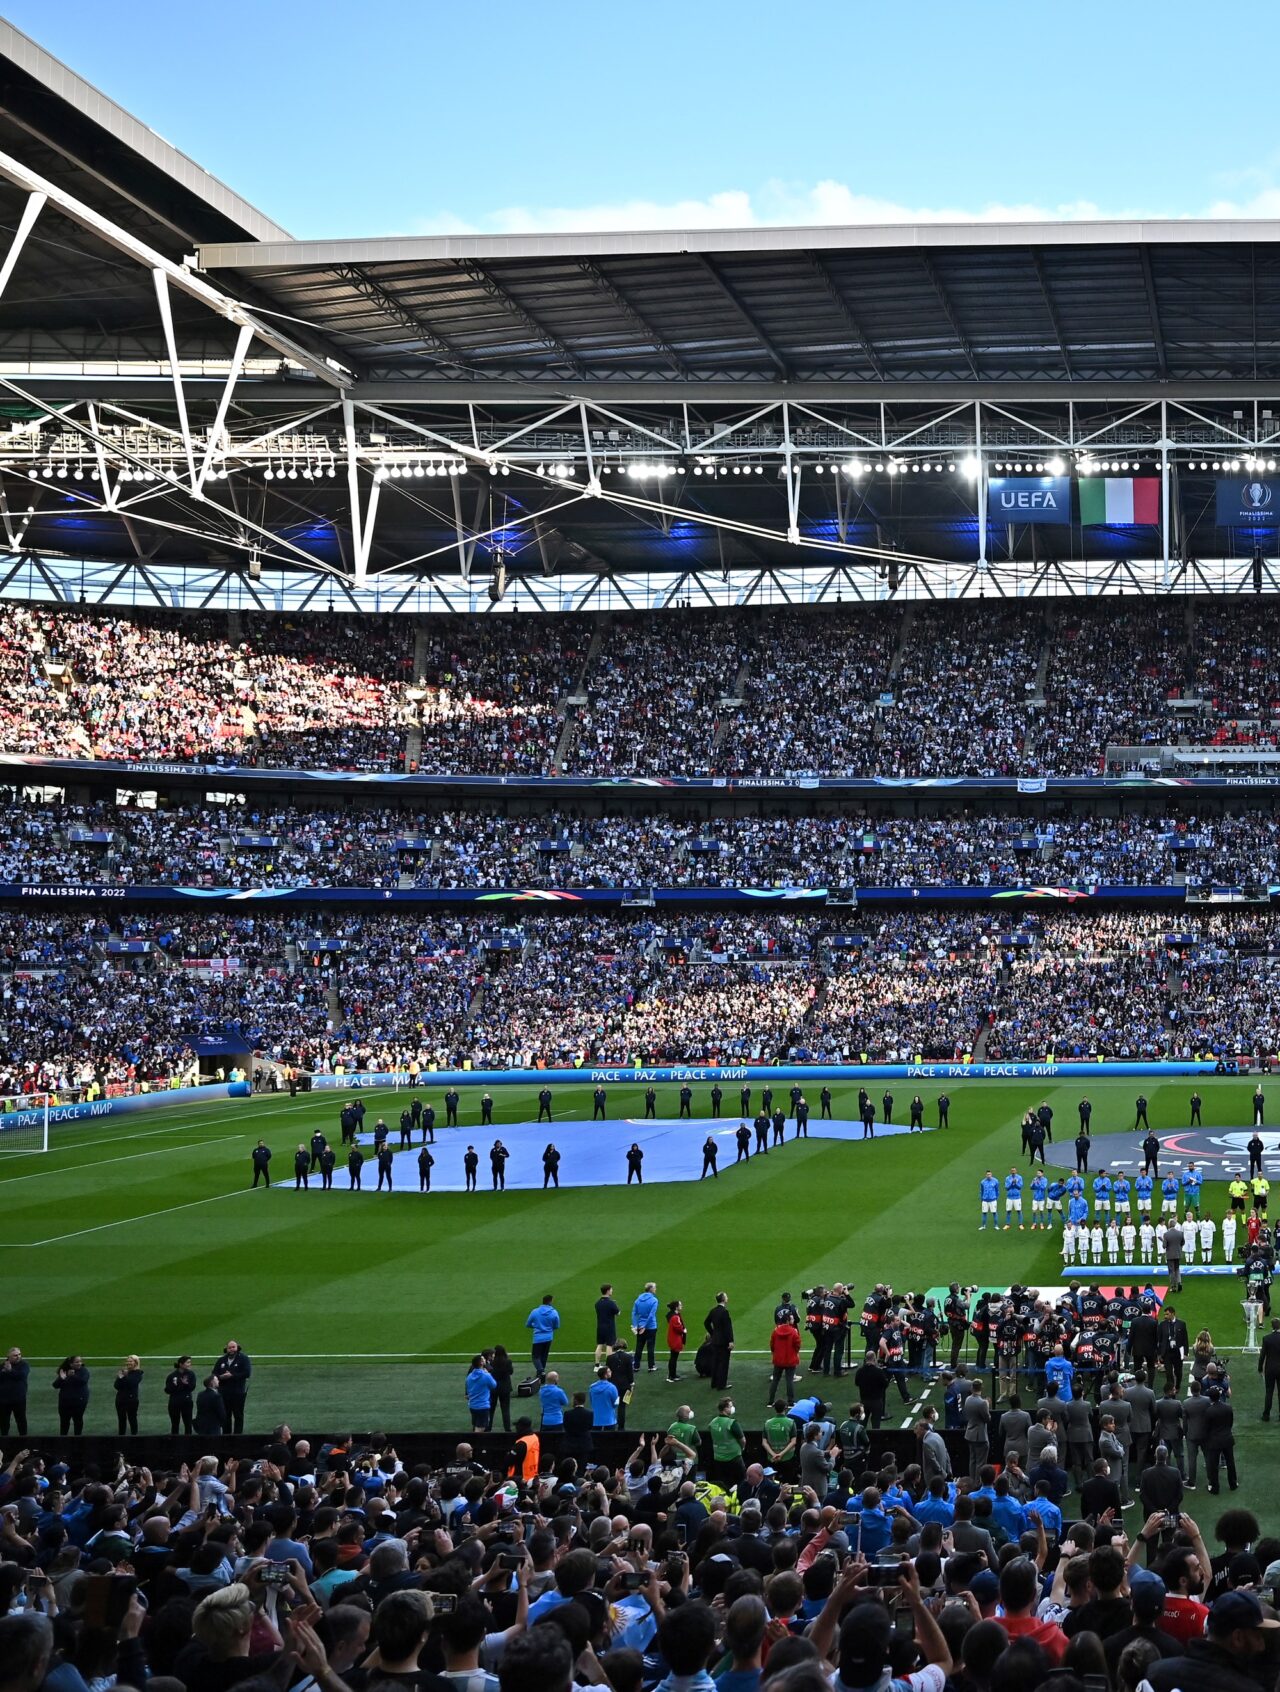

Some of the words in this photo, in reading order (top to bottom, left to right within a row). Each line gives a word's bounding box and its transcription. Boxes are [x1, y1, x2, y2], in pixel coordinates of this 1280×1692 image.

[1000, 491, 1057, 510] UEFA
[127, 764, 187, 774] FINALISSIMA
[21, 887, 96, 897] FINALISSIMA
[101, 888, 126, 897] 2022
[591, 1069, 621, 1081] PACE
[634, 1069, 657, 1081] PAZ
[670, 1069, 706, 1081] PEACE
[720, 1069, 748, 1081] МИР
[907, 1066, 935, 1077] PACE
[949, 1066, 970, 1077] PAZ
[983, 1066, 1019, 1077] PEACE
[1033, 1066, 1058, 1077] МИР
[336, 1075, 377, 1087] PEACE
[18, 1113, 37, 1126] PAZ
[49, 1106, 80, 1121] PEACE
[91, 1102, 112, 1116] МИР
[1124, 1306, 1139, 1316] UEFA
[1095, 1338, 1111, 1347] UEFA
